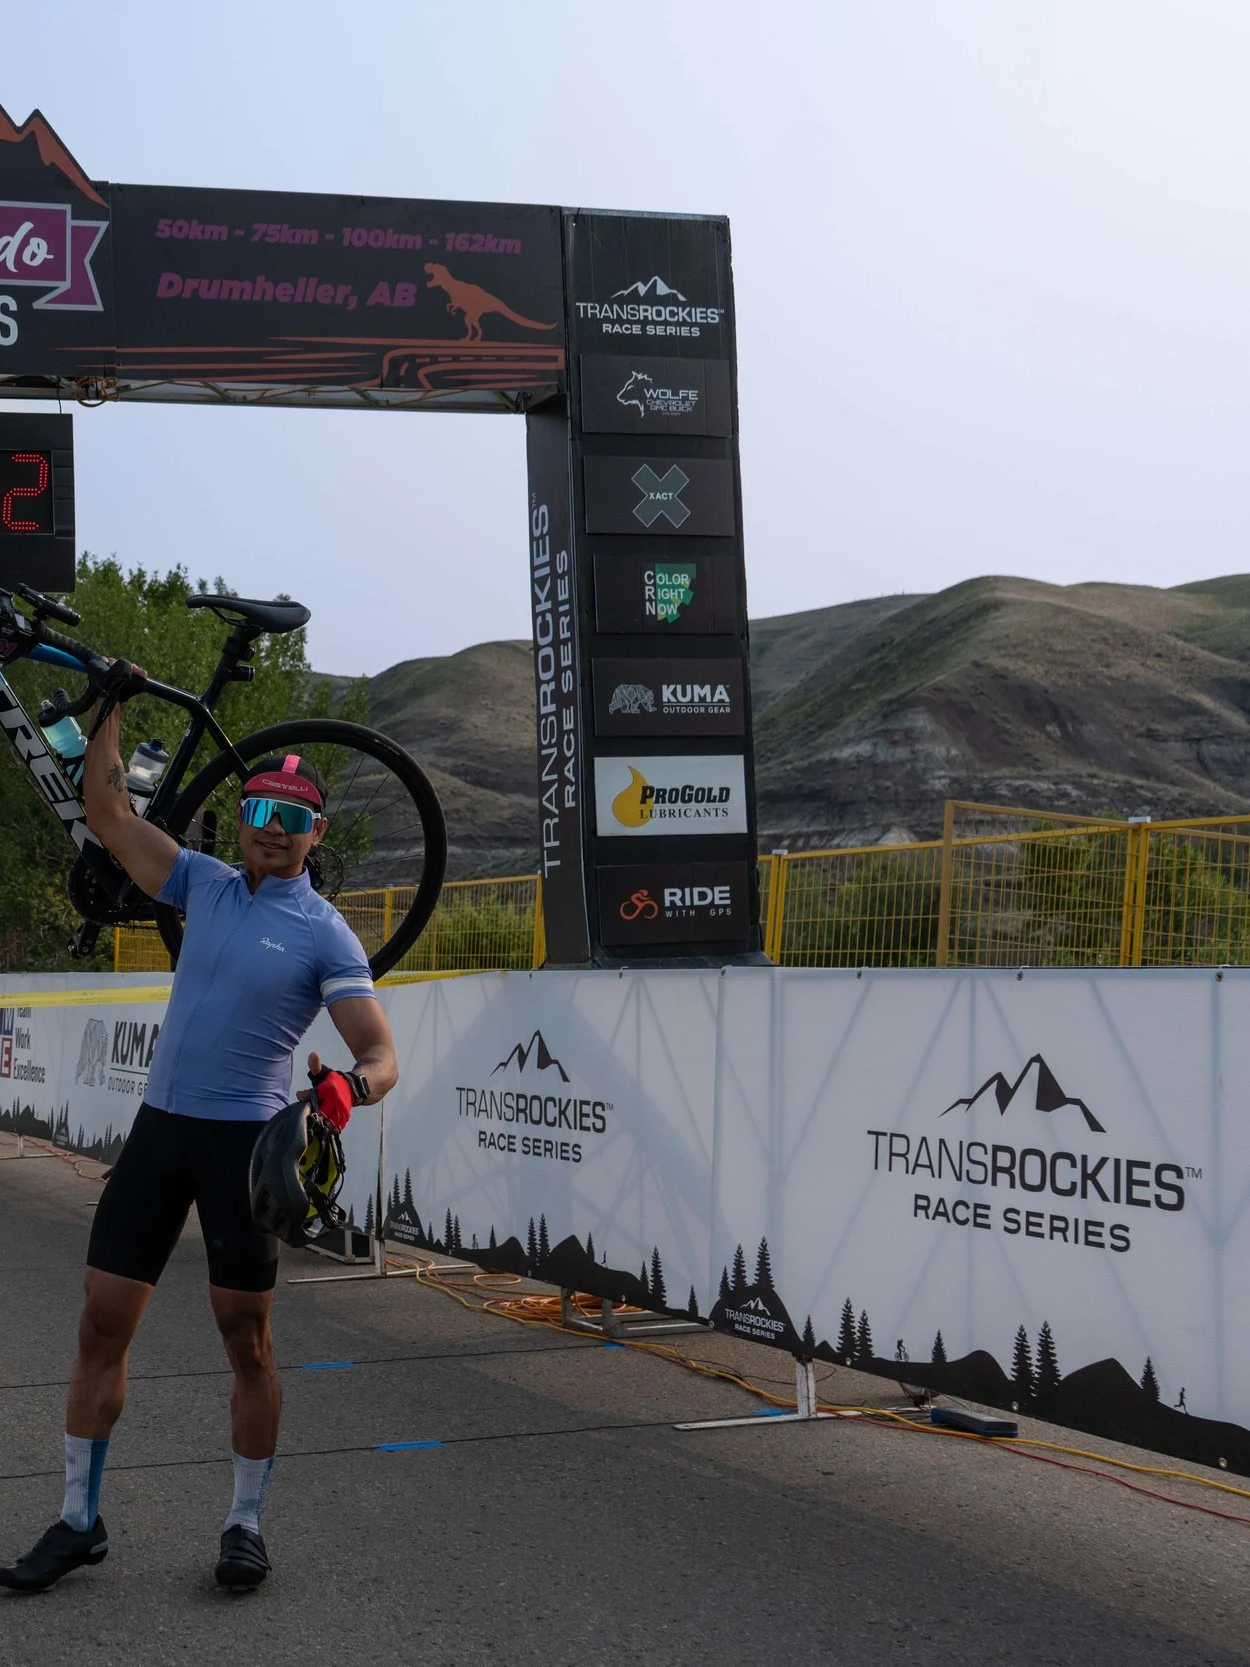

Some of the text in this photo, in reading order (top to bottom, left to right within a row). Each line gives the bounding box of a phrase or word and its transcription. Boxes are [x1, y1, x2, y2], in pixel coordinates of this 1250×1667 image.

[155, 219, 228, 240] 50km
[251, 223, 318, 245] 75km
[341, 228, 422, 251] 100km
[445, 232, 521, 254] 162km
[157, 272, 417, 310] Drumheller, AB
[602, 323, 700, 337] RACE SERIES
[643, 389, 698, 400] WOLFE
[649, 492, 673, 500] XACT
[644, 570, 690, 585] COLOR
[645, 586, 686, 600] RIGHT
[645, 603, 678, 616] NOW
[556, 550, 576, 808] RACE SERIES
[662, 706, 731, 714] OUTDOOR GEAR
[640, 808, 729, 819] LUBRICANTS
[664, 886, 731, 906] RIDE
[665, 908, 732, 918] WITH GPS
[15, 1028, 31, 1049] Work
[111, 1021, 159, 1068] KUMA
[13, 1058, 45, 1083] Excellence
[108, 1076, 135, 1095] OUTDOOR
[478, 1130, 582, 1163] RACE SERIES
[913, 1193, 1131, 1253] RACE SERIES
[735, 1323, 776, 1339] RACE SERIES
